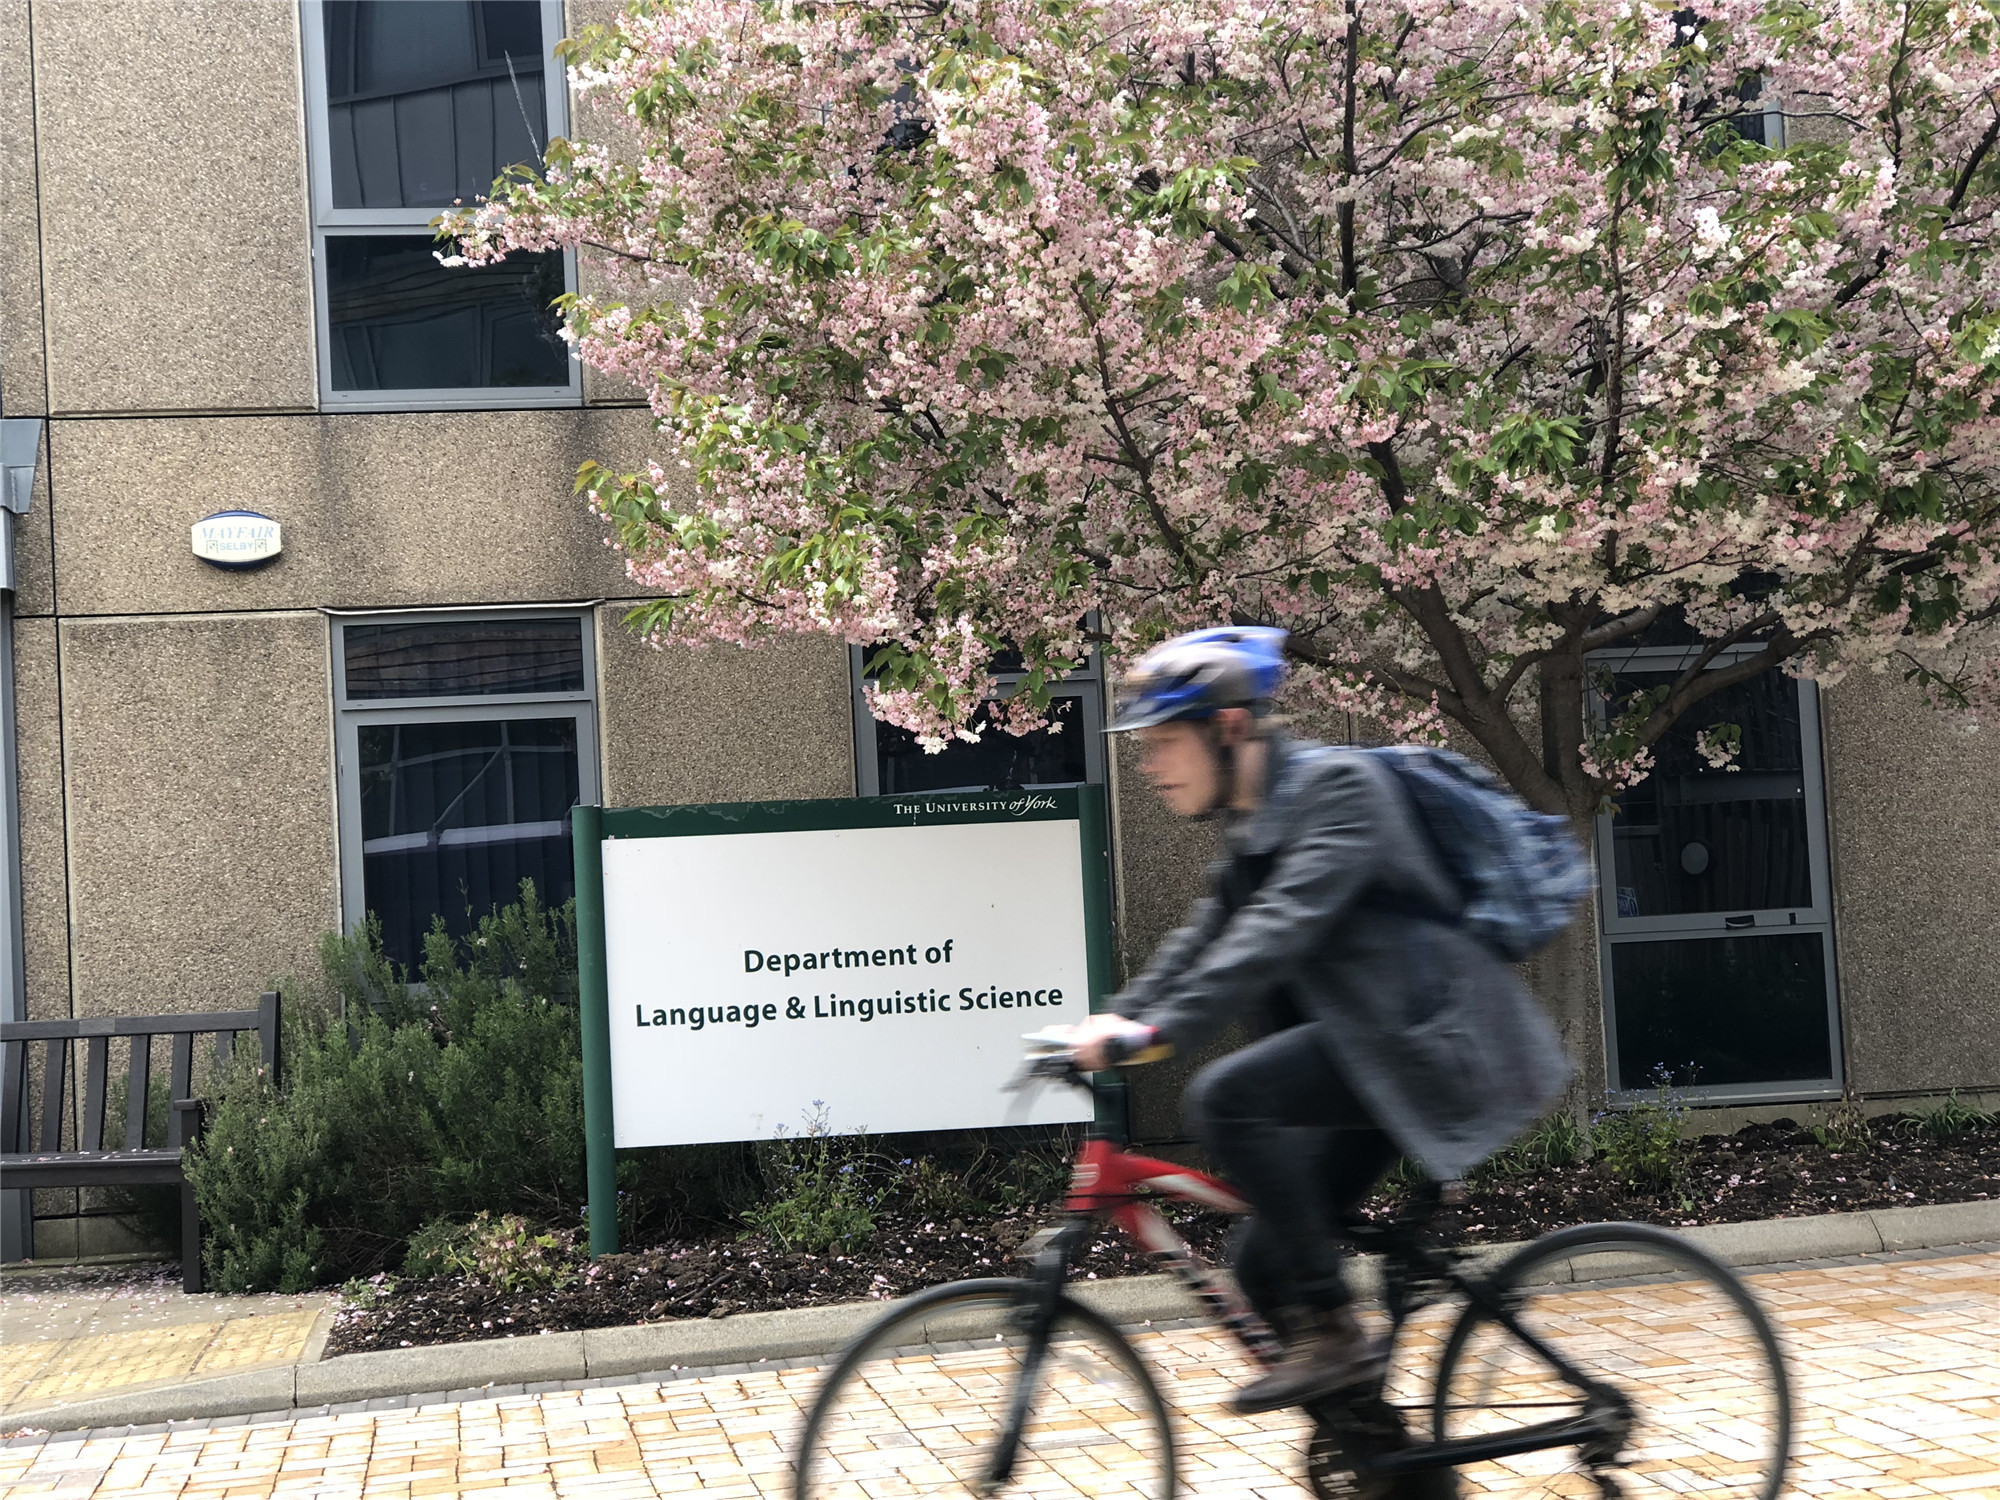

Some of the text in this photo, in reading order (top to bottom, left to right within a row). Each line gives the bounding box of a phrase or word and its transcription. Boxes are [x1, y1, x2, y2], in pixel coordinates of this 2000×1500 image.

[219, 541, 254, 551] SELBY
[926, 801, 1007, 814] UNIVERSITY
[1008, 797, 1026, 812] of
[1010, 794, 1058, 817] York
[744, 938, 954, 977] Department of
[636, 985, 1063, 1031] Language & Linguistic Science
